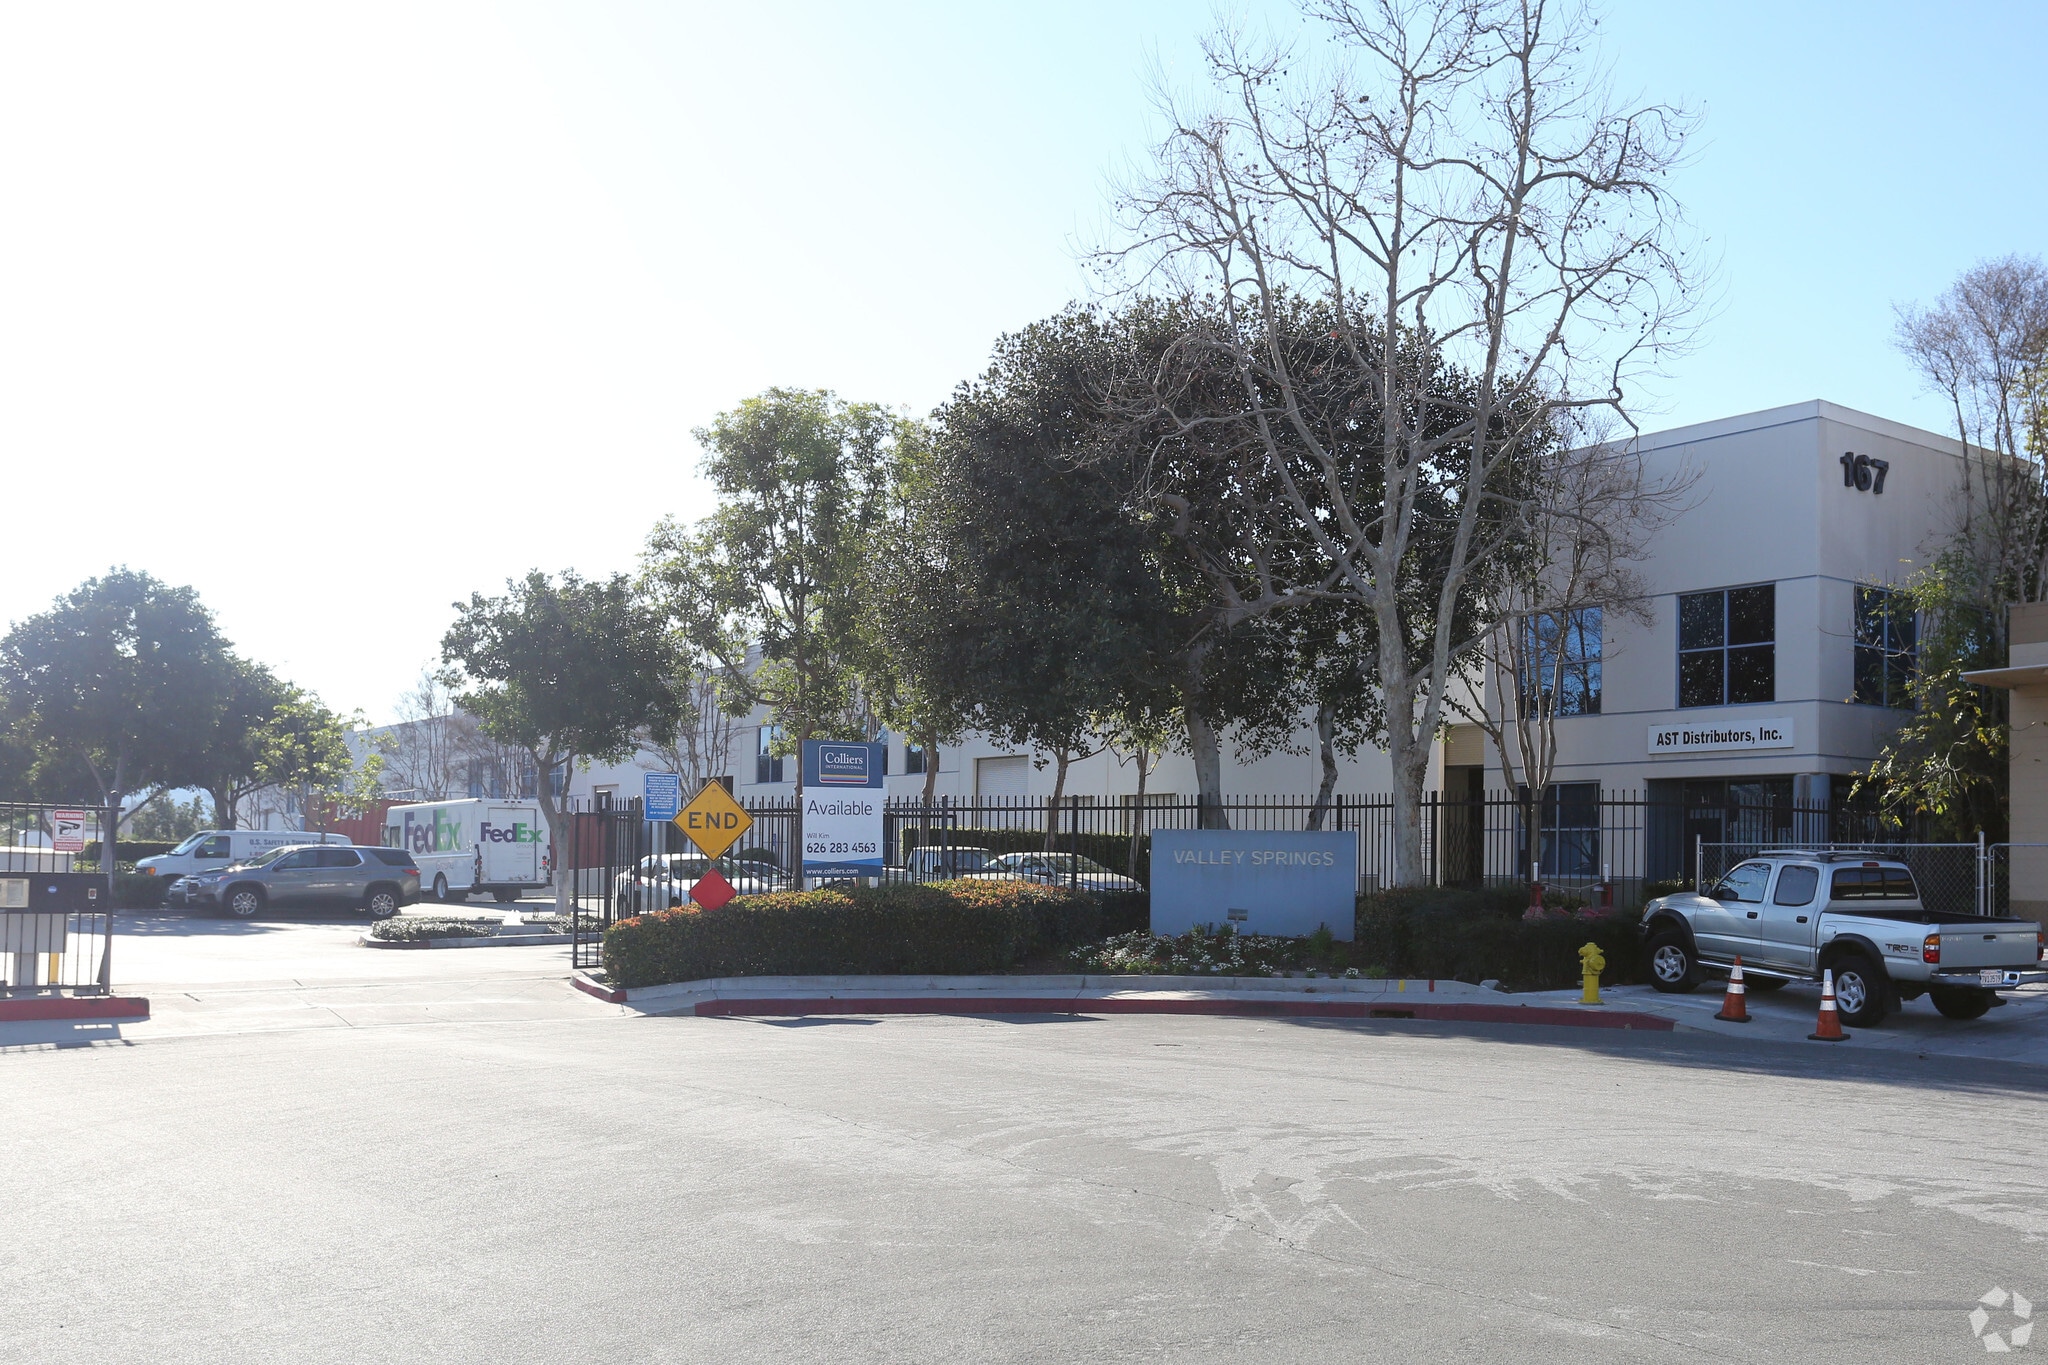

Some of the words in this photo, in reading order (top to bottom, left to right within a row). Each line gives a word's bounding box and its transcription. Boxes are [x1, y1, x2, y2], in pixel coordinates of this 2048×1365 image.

[1840, 451, 1889, 495] 167
[1656, 732, 1679, 746] AST
[1682, 729, 1756, 745] Distributors,
[1759, 727, 1782, 741] Inc.
[825, 752, 863, 765] Colliers
[807, 800, 873, 816] Available
[688, 811, 739, 830] END
[405, 808, 462, 854] FedEx
[480, 822, 544, 843] FedEx
[806, 842, 827, 854] 626
[829, 842, 849, 854] 283
[851, 842, 877, 854] 4563
[1173, 850, 1246, 866] VALLEY
[1251, 850, 1335, 867] SPRINGS
[806, 867, 859, 875] www.colliers.com
